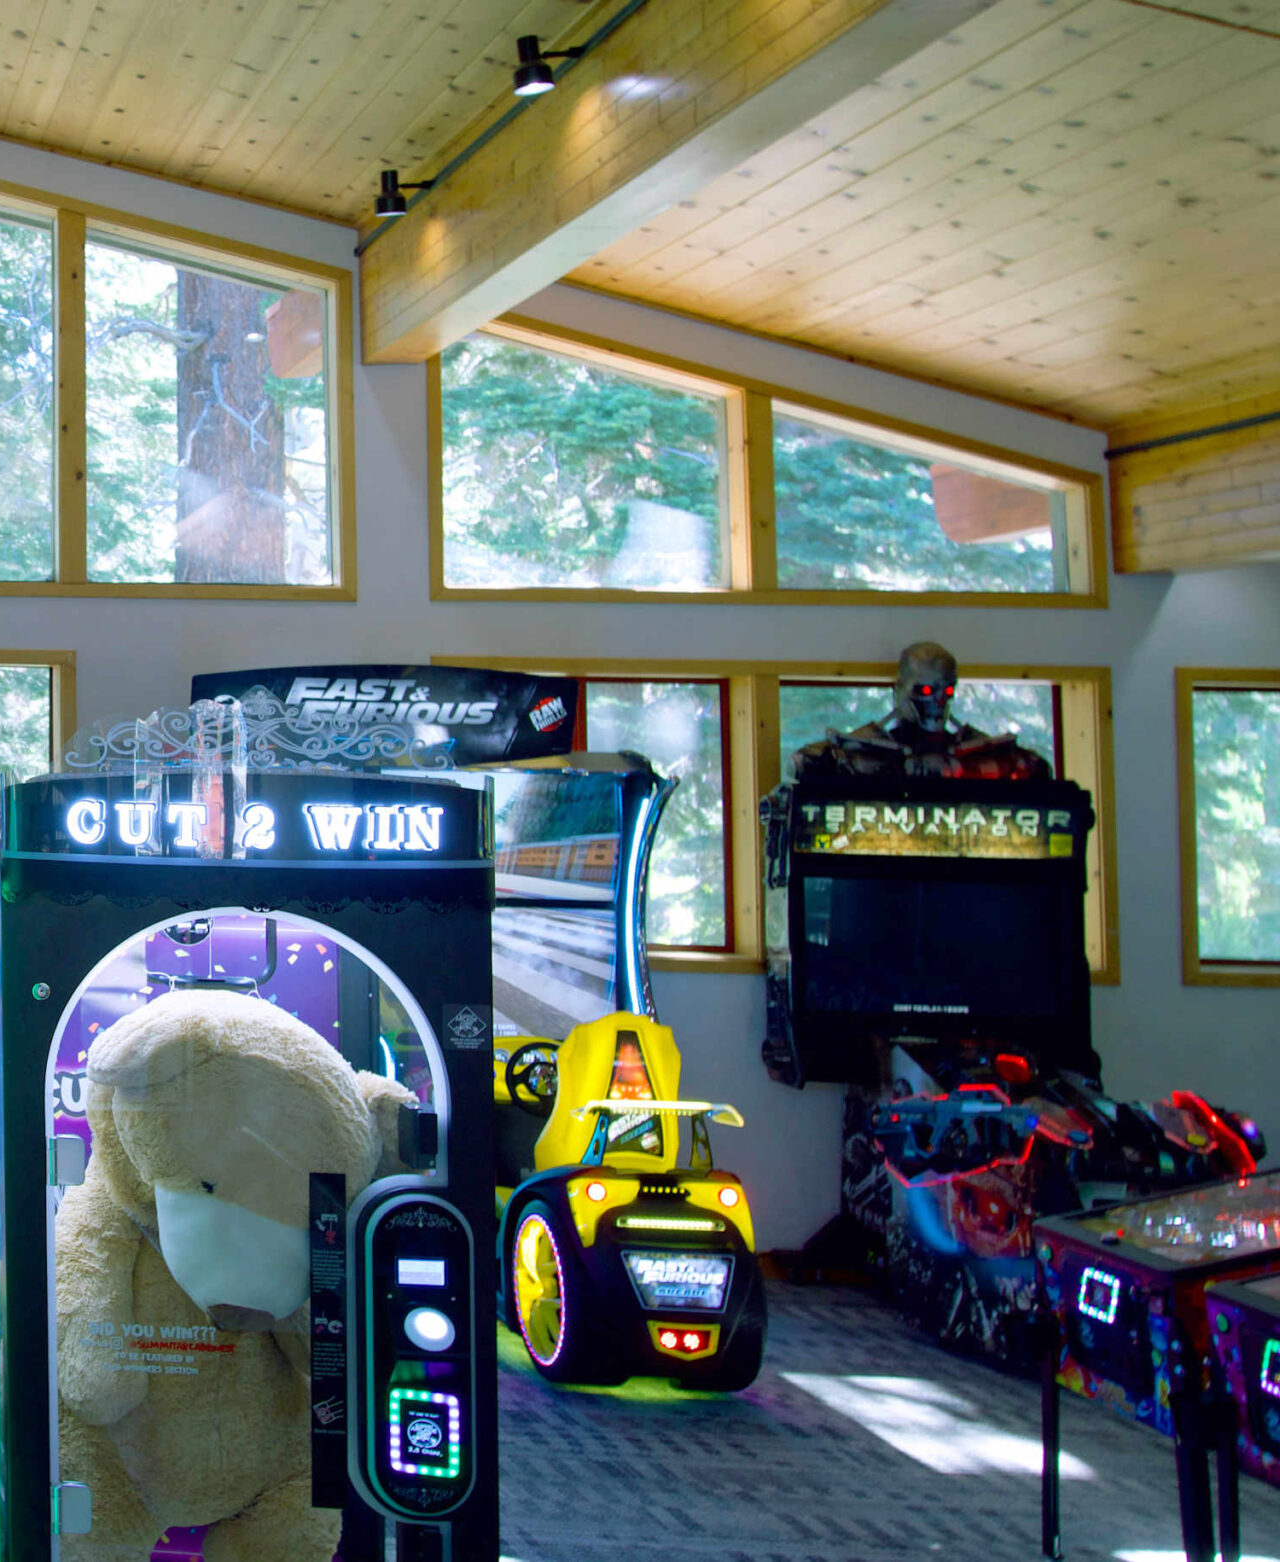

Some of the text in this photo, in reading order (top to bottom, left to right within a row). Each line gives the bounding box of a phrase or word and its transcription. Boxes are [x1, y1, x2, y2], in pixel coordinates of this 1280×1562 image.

[285, 677, 430, 704] FAST &
[296, 702, 498, 727] FURIOUS
[67, 799, 444, 850] CUT 2 WIN
[802, 805, 1070, 827] TERMINATOR
[825, 822, 1038, 836] SALVATION
[642, 1272, 725, 1285] FURIOUS
[89, 1322, 217, 1341] DID YOU WIN???
